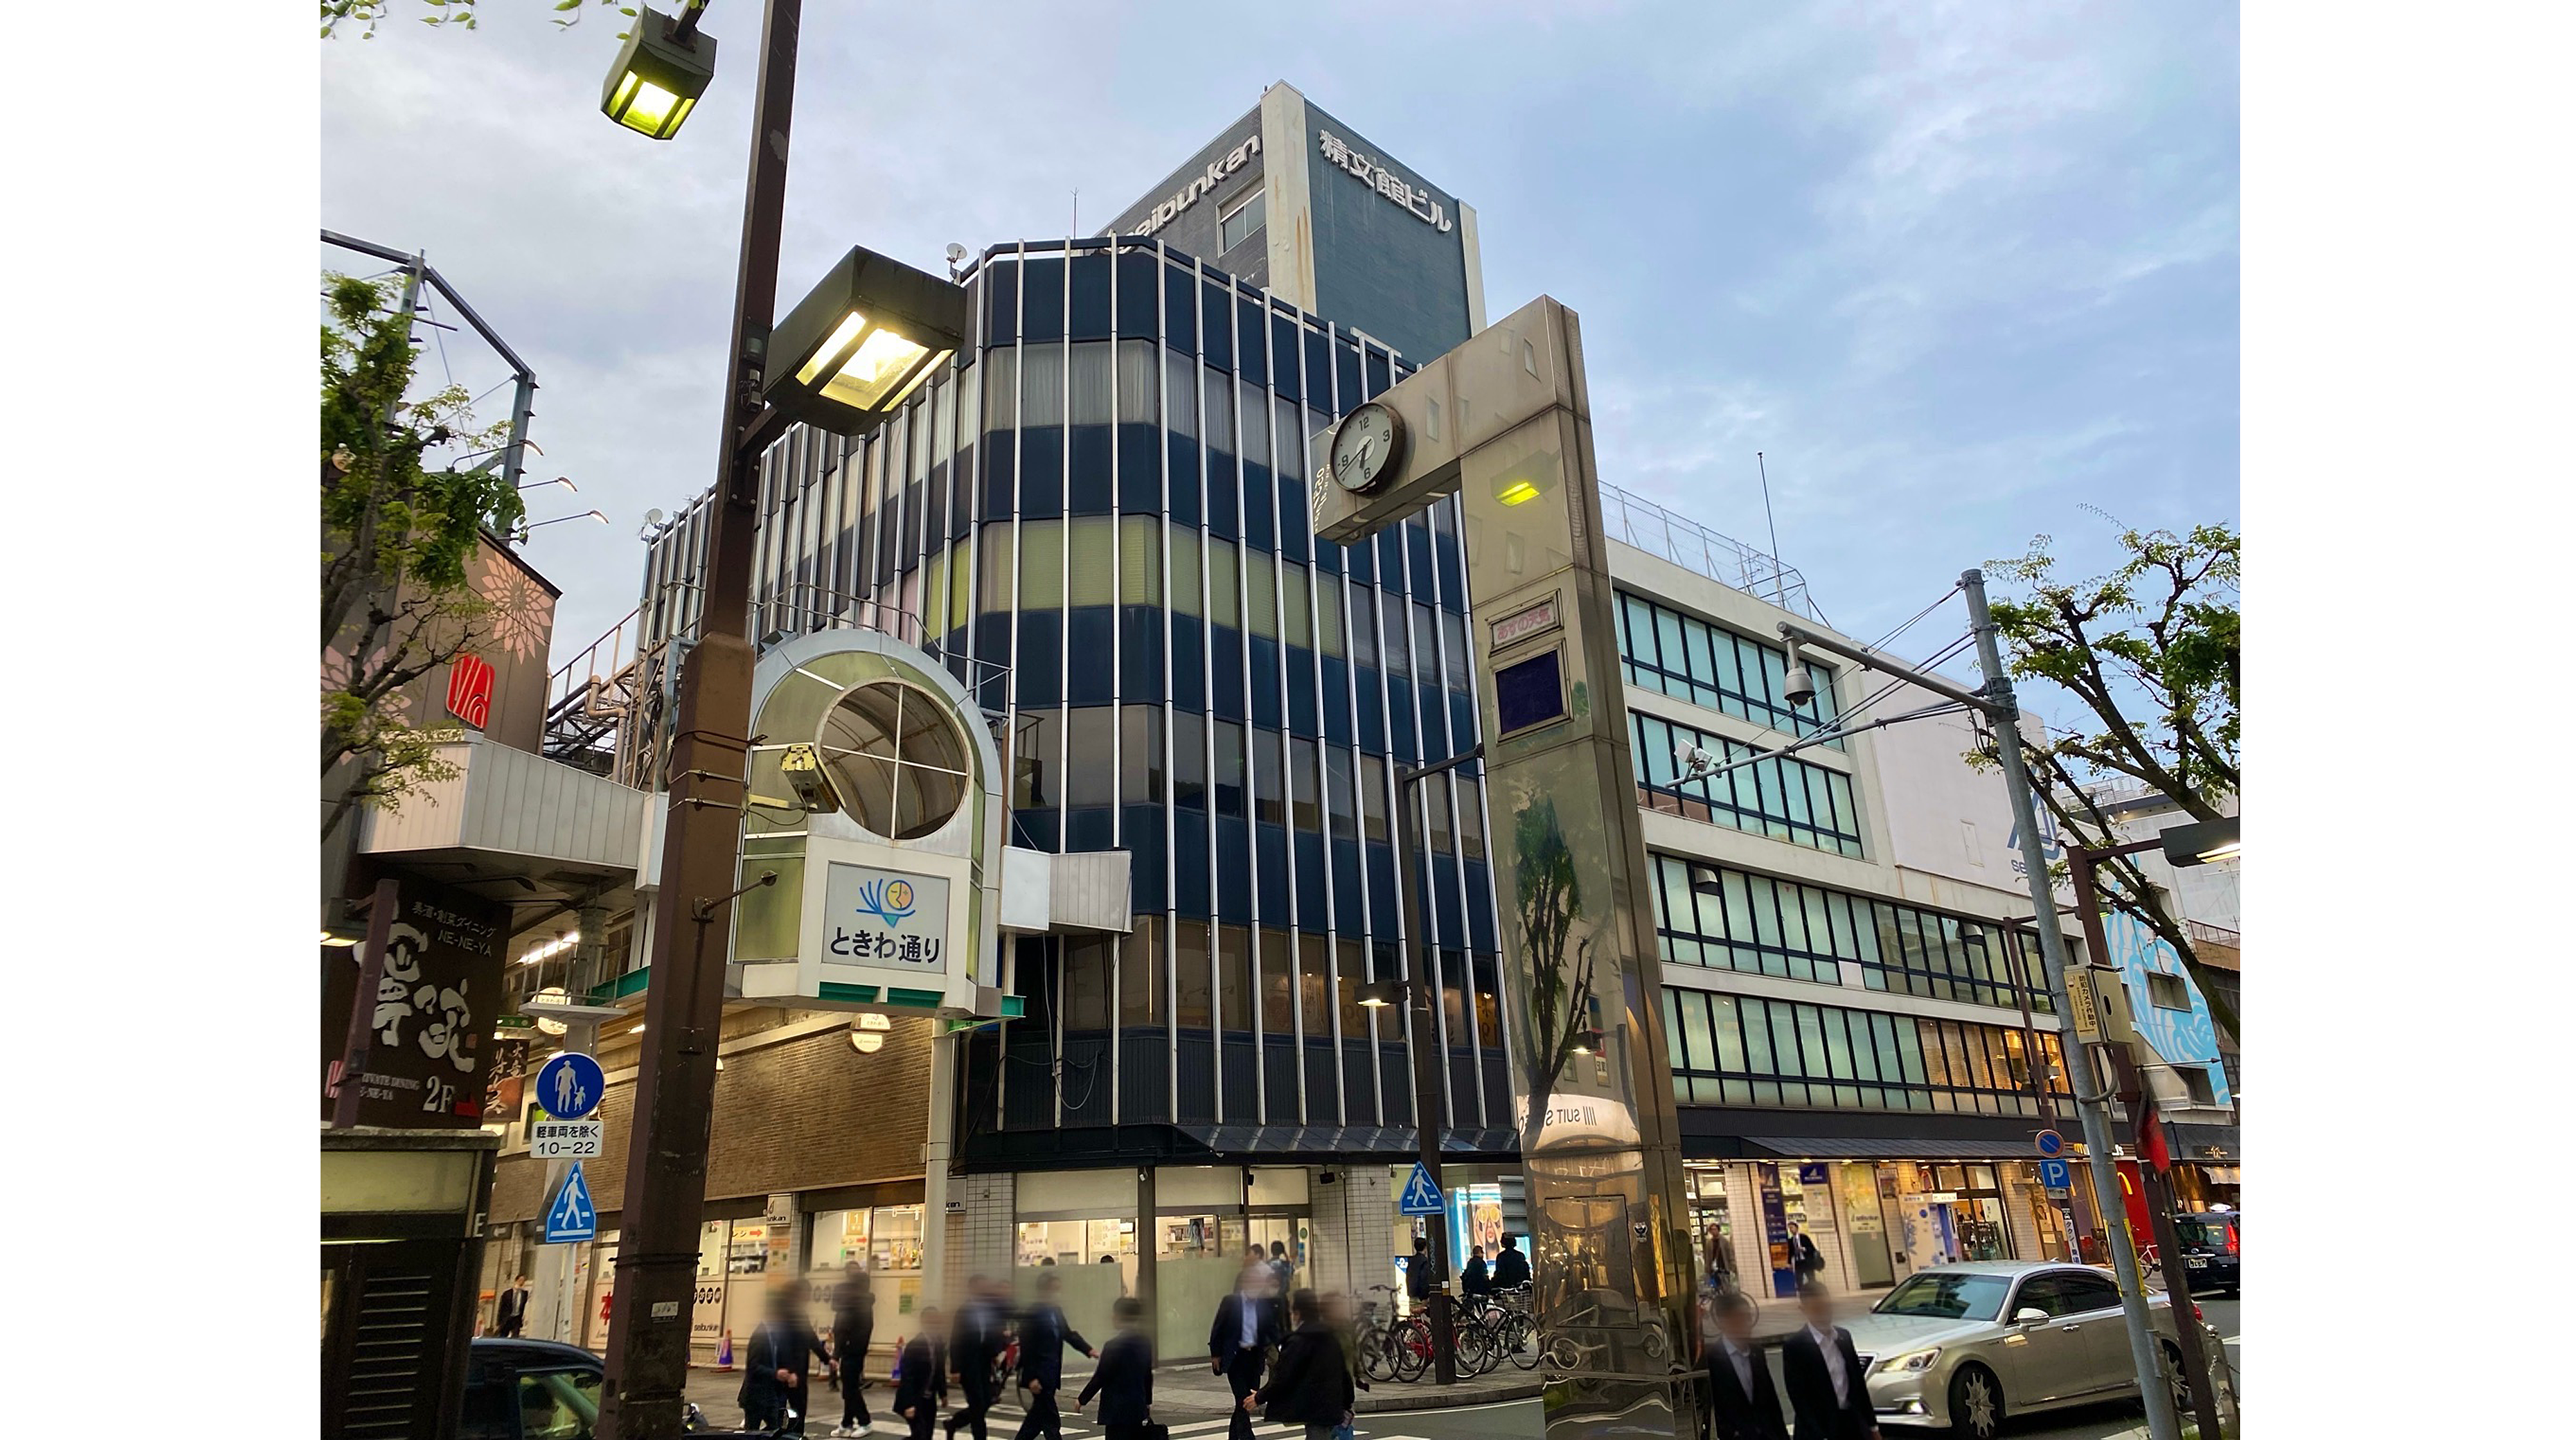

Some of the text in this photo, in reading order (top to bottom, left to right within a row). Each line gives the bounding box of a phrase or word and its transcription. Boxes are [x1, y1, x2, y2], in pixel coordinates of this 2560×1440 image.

[1319, 129, 1453, 233] 精文館ビル
[1358, 416, 1370, 431] 12
[1382, 429, 1391, 442] 3
[1341, 454, 1349, 467] 9
[1363, 467, 1371, 479] 6
[437, 930, 492, 958] NE-NE-YA
[830, 927, 940, 963] ときわ通り
[422, 1075, 455, 1113] 2F
[536, 1125, 600, 1139] 軽車両を除く
[538, 1141, 595, 1155] 10-22
[2047, 1162, 2064, 1186] P
